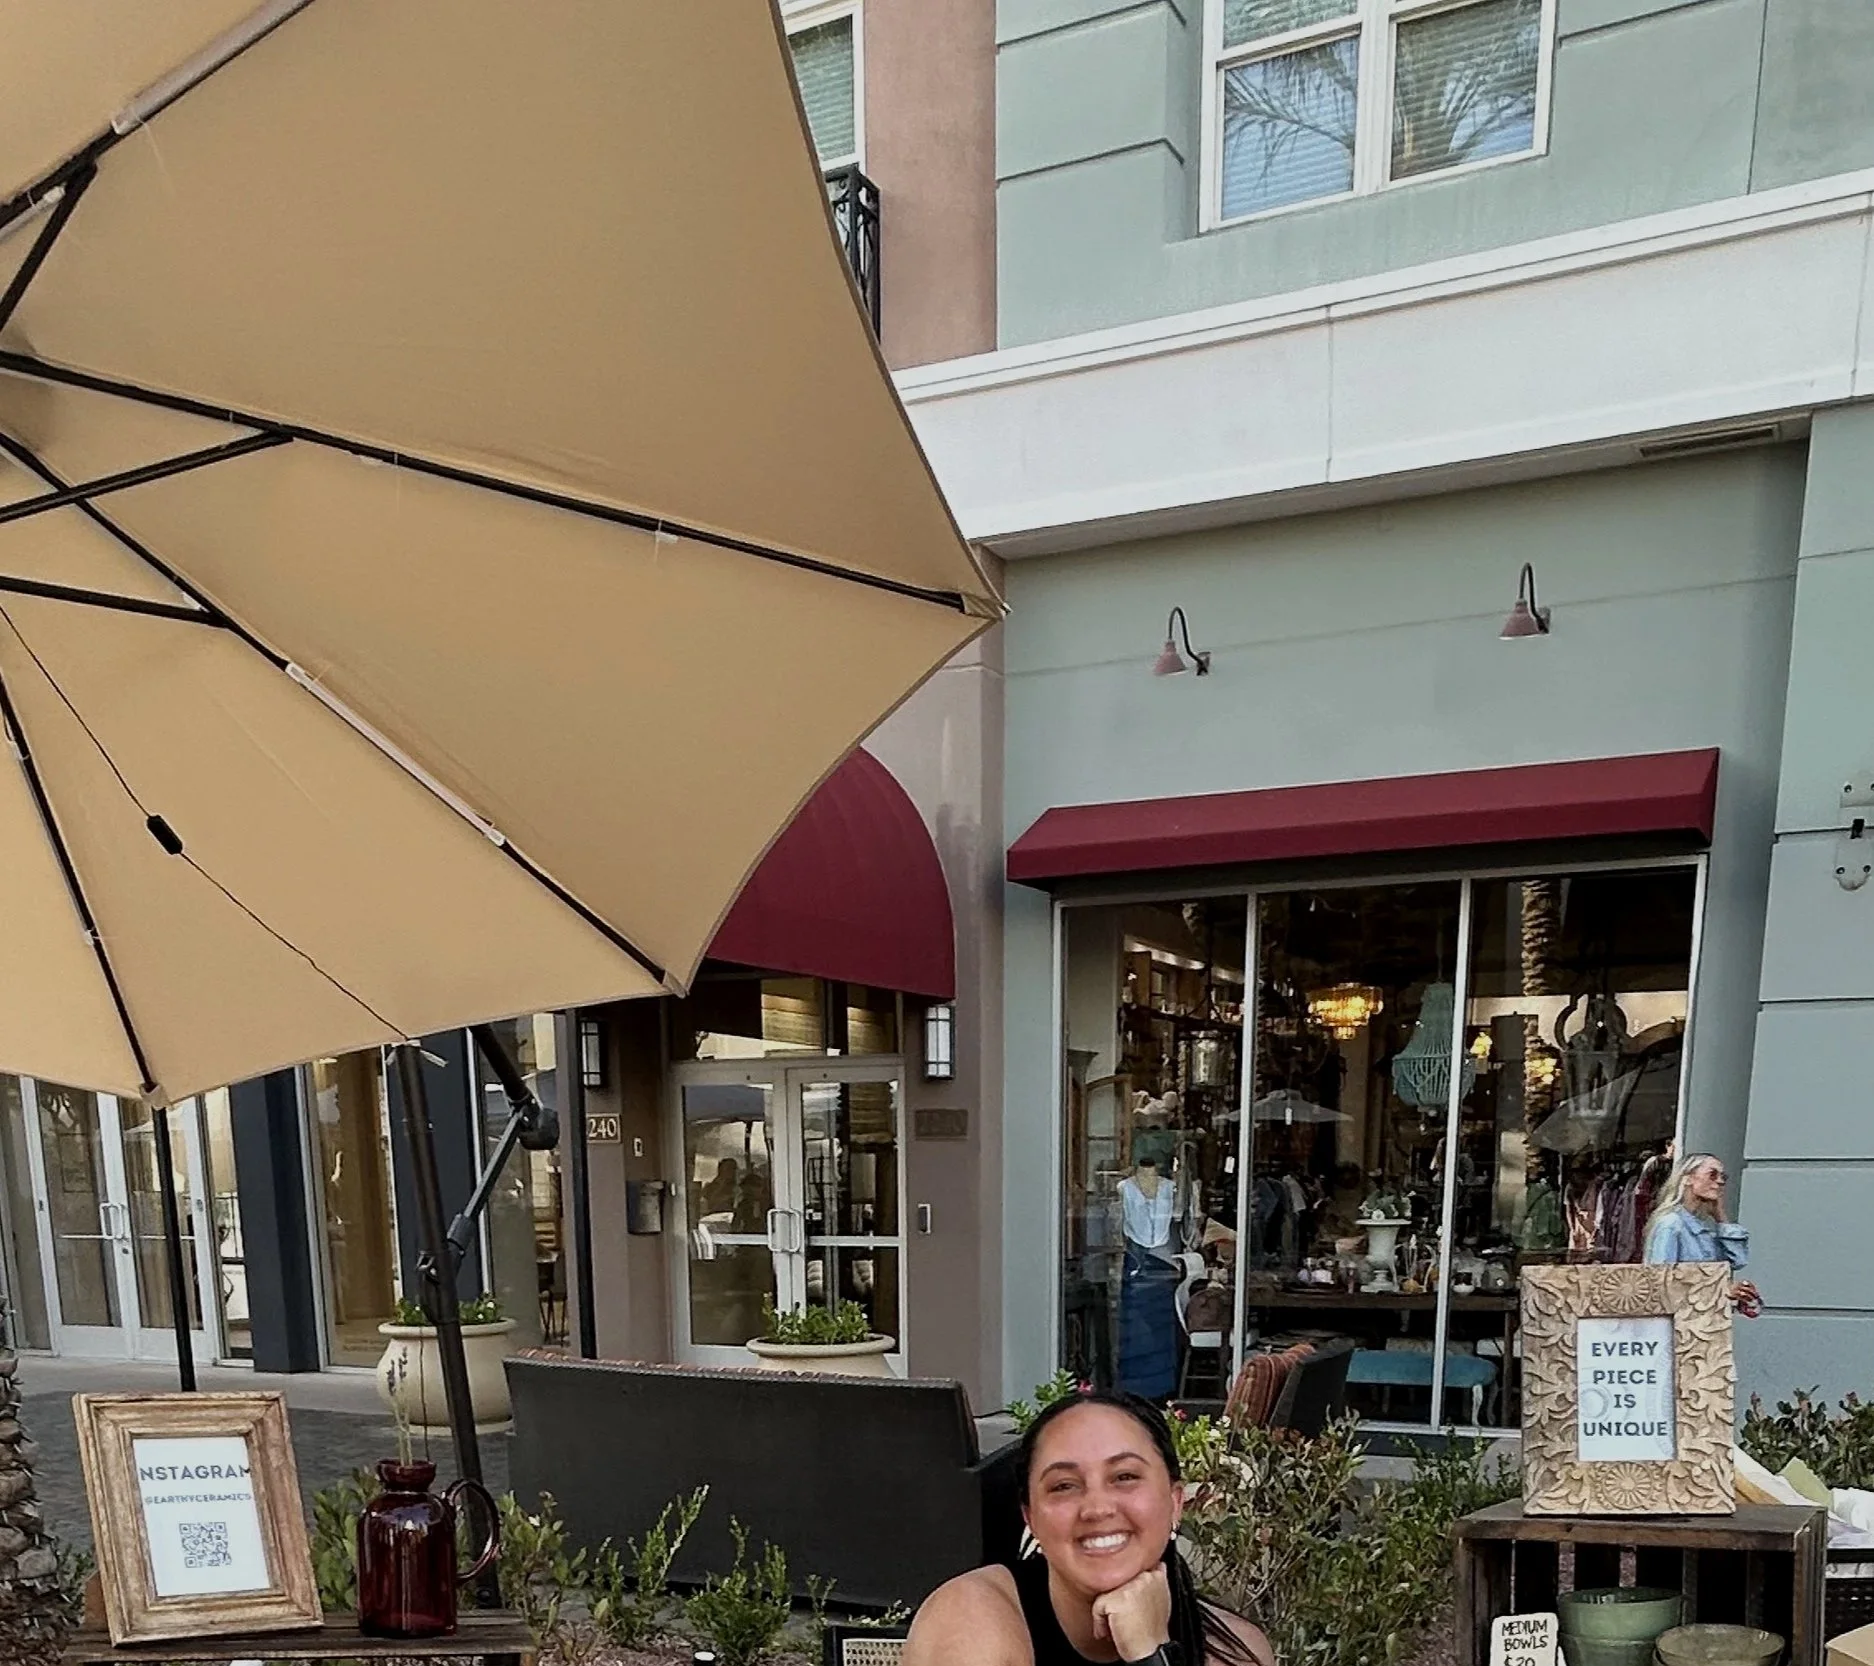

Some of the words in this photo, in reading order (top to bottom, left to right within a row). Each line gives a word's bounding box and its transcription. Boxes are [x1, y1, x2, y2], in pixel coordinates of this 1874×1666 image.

[1591, 1340, 1659, 1357] EVERY
[1593, 1369, 1657, 1385] PIECE
[1613, 1393, 1637, 1409] IS
[1583, 1420, 1668, 1437] UNIQUE
[1501, 1618, 1548, 1637] MEDIUM
[1503, 1635, 1549, 1652] BOWLS
